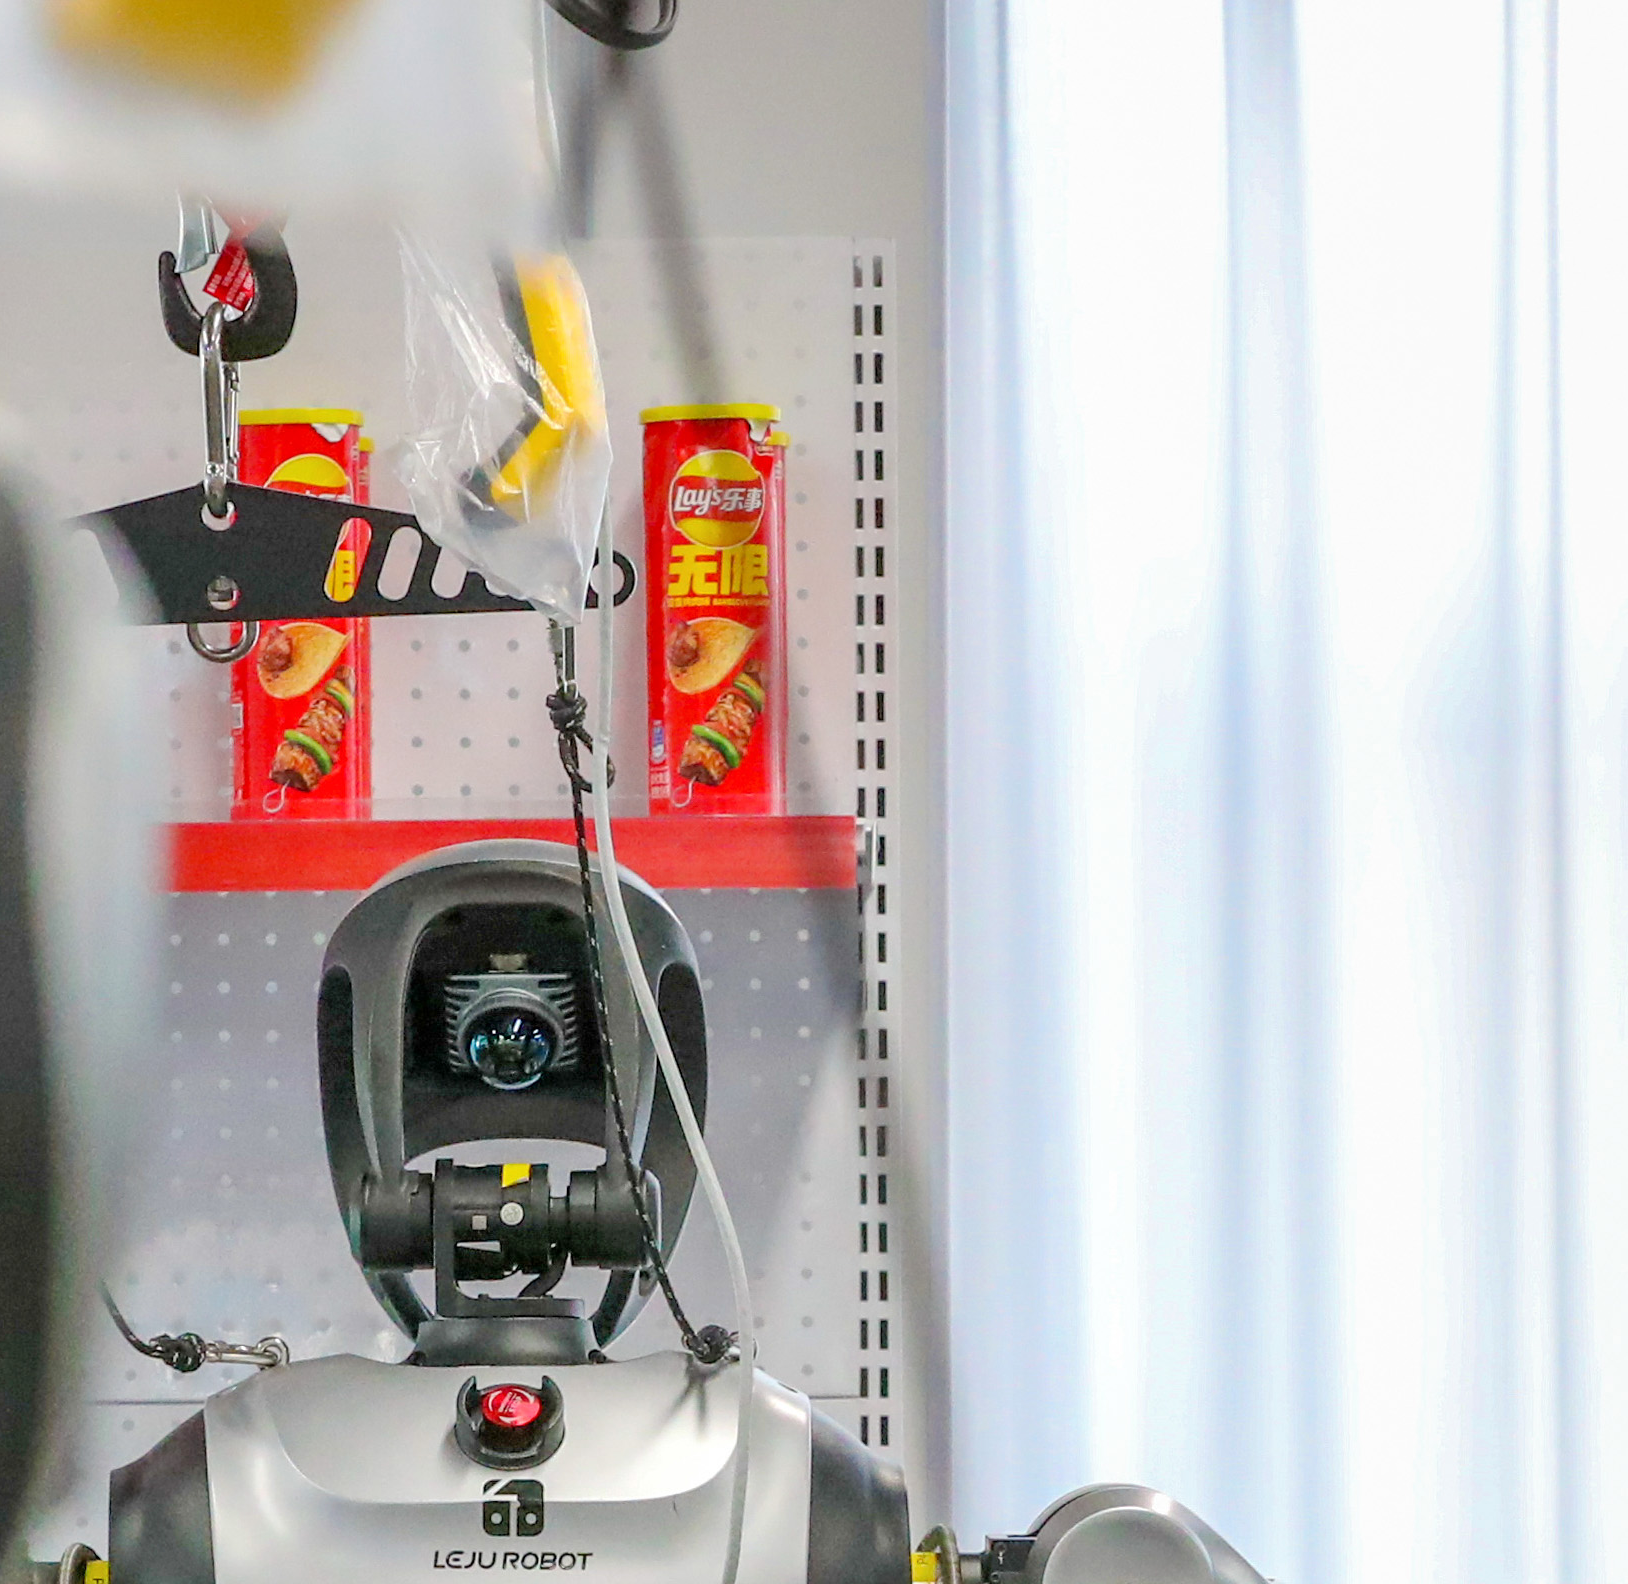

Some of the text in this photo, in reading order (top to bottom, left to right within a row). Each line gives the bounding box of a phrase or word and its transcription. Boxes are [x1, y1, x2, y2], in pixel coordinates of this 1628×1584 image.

[673, 486, 763, 515] Lay's 乐事
[668, 544, 769, 596] 无限
[433, 1550, 593, 1571] LEJU ROBOT
